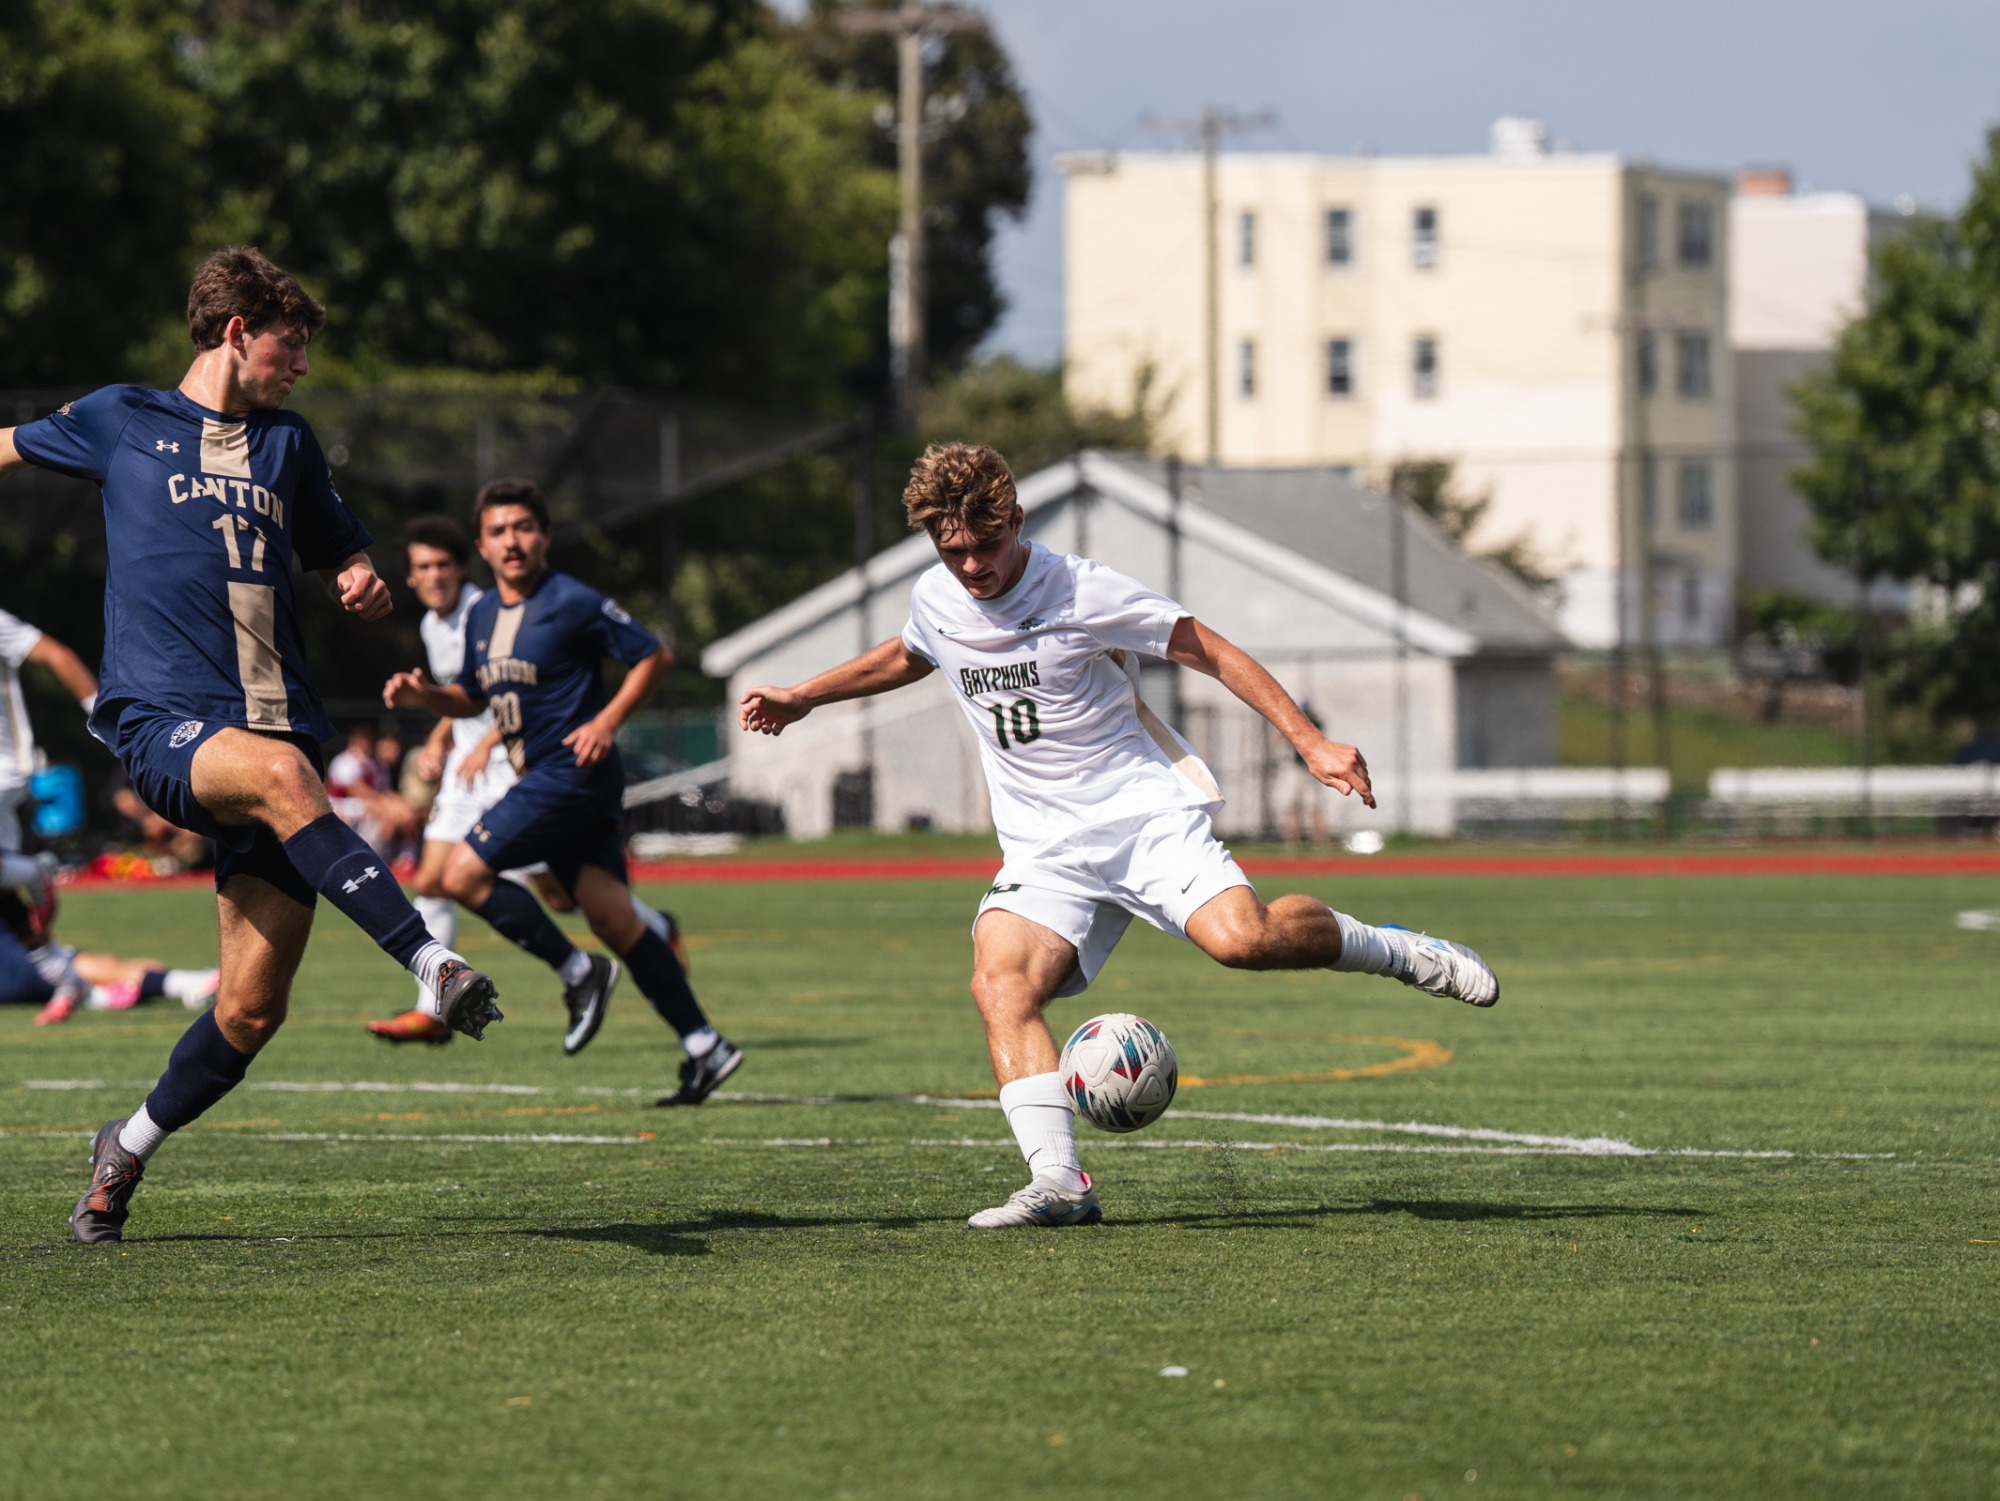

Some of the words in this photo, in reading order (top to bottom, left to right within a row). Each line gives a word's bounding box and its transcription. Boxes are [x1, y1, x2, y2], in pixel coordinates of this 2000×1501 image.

[168, 473, 283, 530] CANTON
[212, 513, 267, 572] 17
[960, 660, 1040, 698] GRYPHONS
[987, 698, 1041, 750] 10
